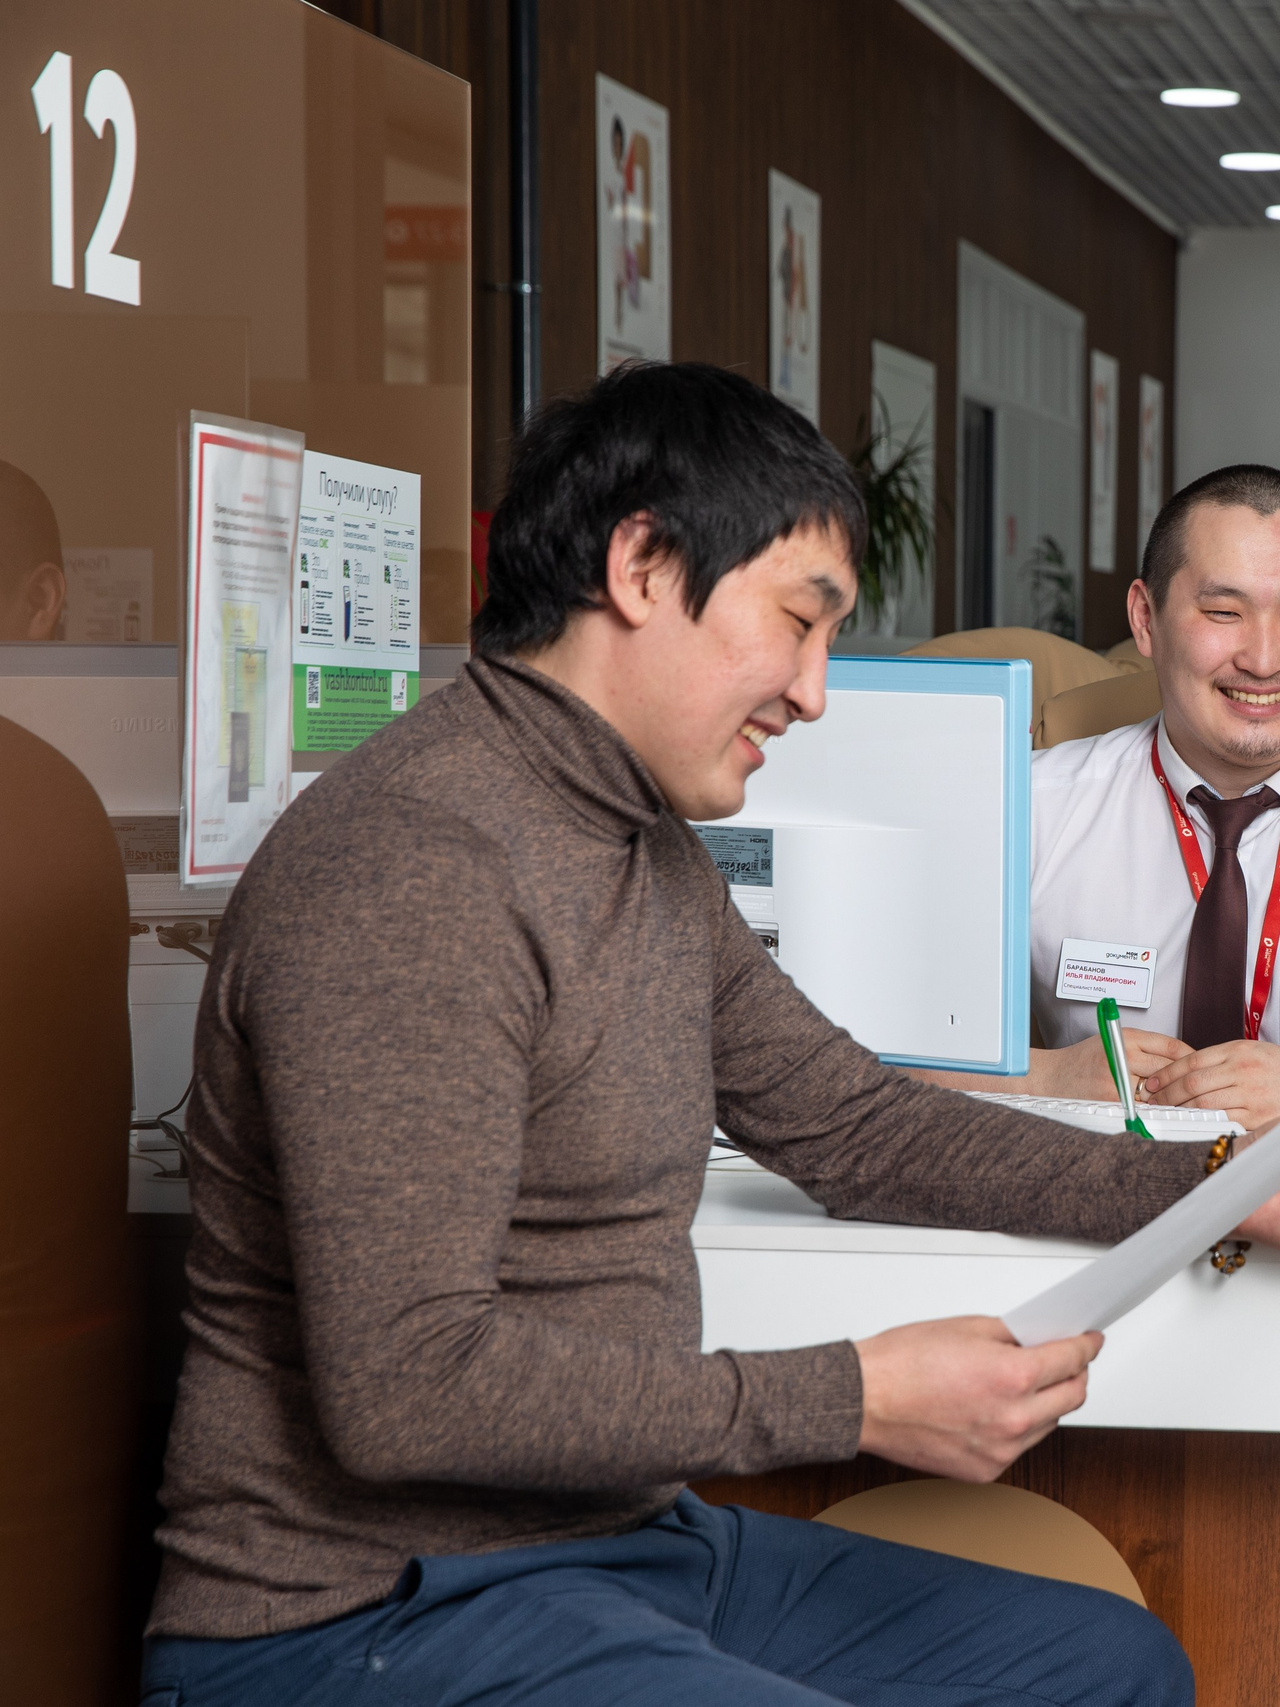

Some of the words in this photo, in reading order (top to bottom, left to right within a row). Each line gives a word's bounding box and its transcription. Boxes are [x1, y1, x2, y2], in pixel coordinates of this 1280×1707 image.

[30, 50, 142, 307] 12
[319, 470, 365, 506] Получили
[366, 485, 398, 516] услугу?
[324, 667, 388, 693] vashkontrol.ru
[1105, 952, 1138, 961] документы
[1066, 963, 1106, 974] БАРАБАНОВ
[1065, 972, 1083, 980] ИЛЬЯ
[1084, 974, 1137, 986] ВЛАДИМИРОВИЧ
[1063, 982, 1093, 991] Специалист
[1093, 986, 1107, 994] МФЦ
